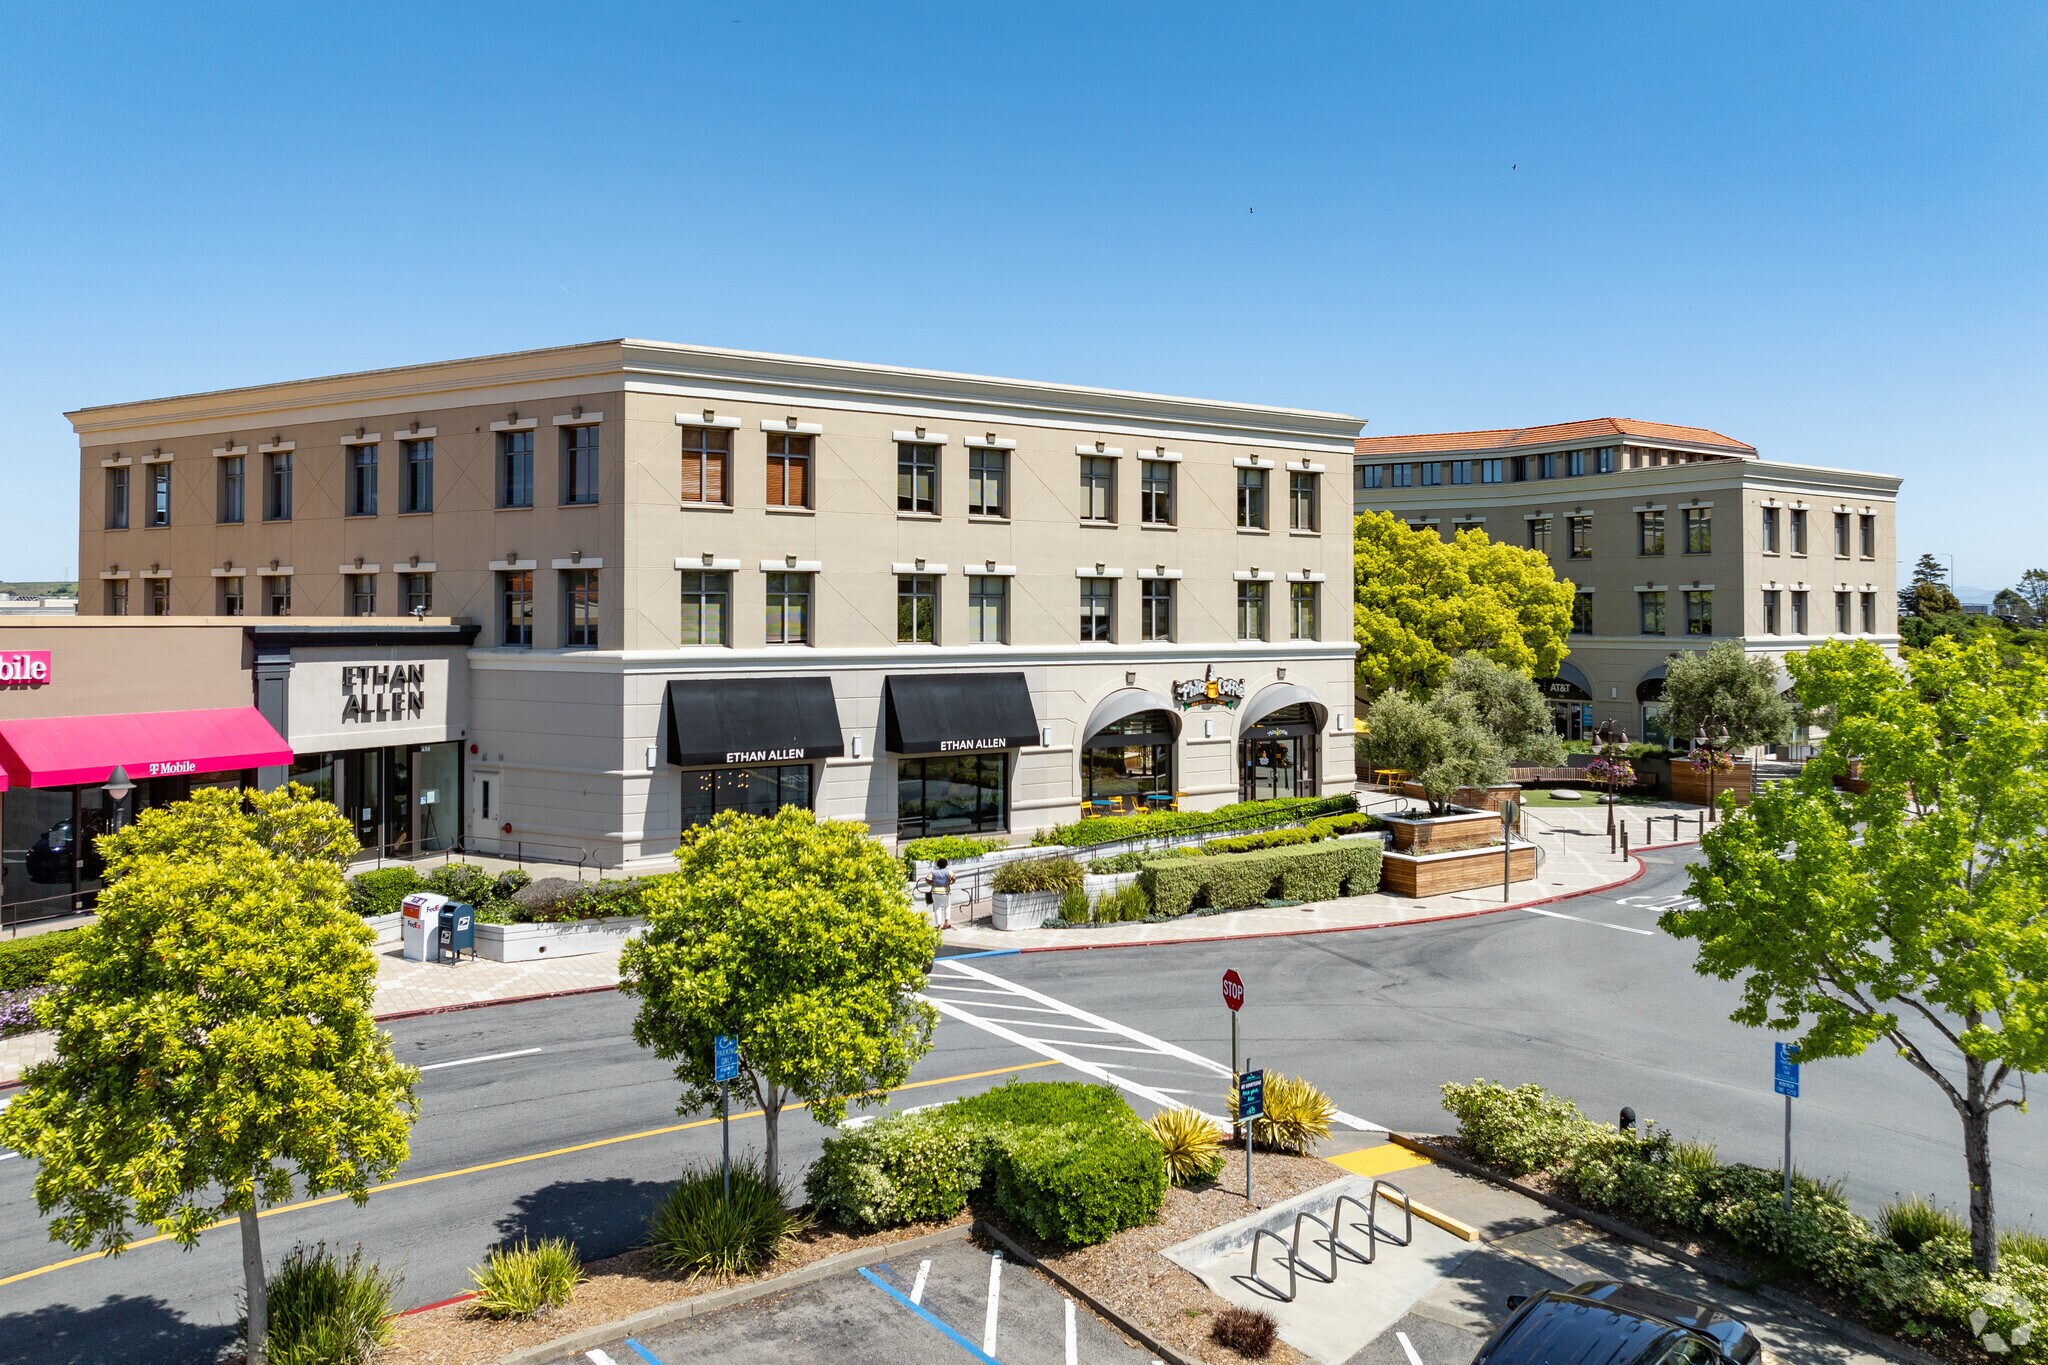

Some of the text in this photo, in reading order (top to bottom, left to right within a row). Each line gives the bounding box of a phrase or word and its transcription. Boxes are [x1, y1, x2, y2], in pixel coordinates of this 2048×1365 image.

[342, 664, 424, 687] ETHAN
[1550, 683, 1571, 692] AT&T
[342, 691, 424, 714] ALLEN
[941, 738, 1006, 751] ETHAN ALLEN
[726, 748, 804, 763] ETHAN ALLEN
[160, 761, 195, 774] Mobile
[426, 904, 442, 913] FedE
[408, 920, 421, 929] FedEx
[1223, 980, 1243, 1000] STOP
